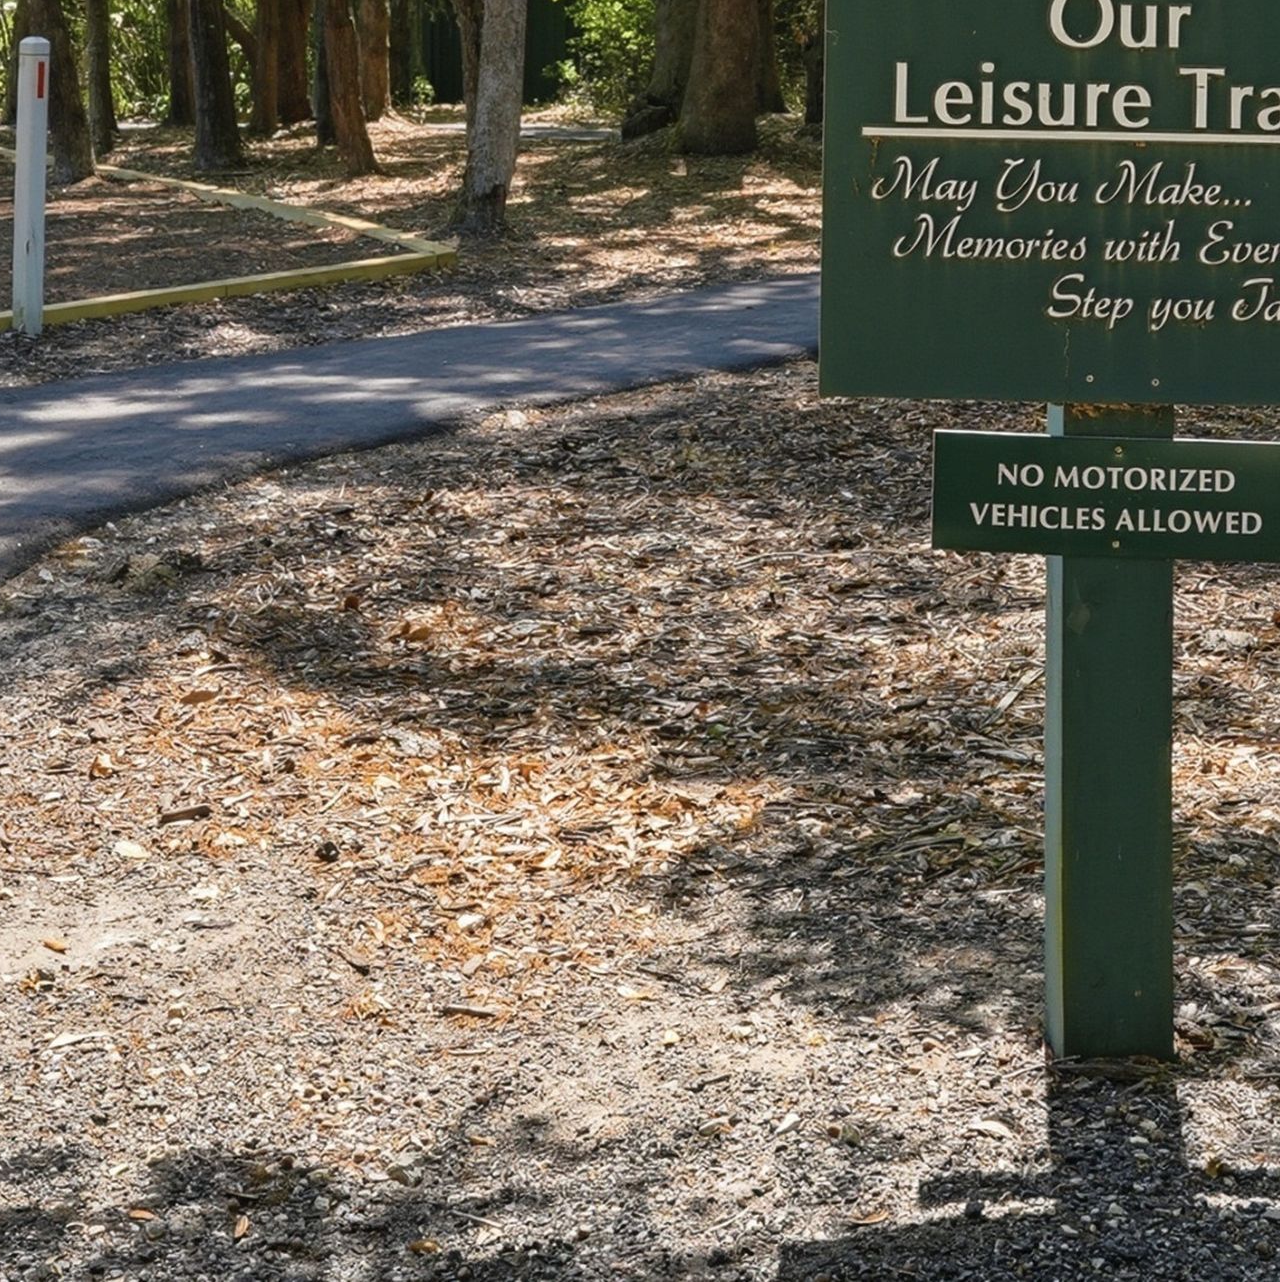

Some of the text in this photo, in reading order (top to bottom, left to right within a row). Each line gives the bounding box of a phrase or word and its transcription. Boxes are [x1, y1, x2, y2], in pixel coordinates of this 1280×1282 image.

[893, 61, 1152, 128] Leisure
[871, 155, 1253, 213] May You Make...
[893, 213, 1087, 261] Memories
[1104, 219, 1181, 262] with
[1047, 273, 1133, 329] Step
[1150, 296, 1215, 330] you
[997, 463, 1236, 493] NO MOTORIZED
[969, 502, 1263, 535] VEHICLES ALLOWED
